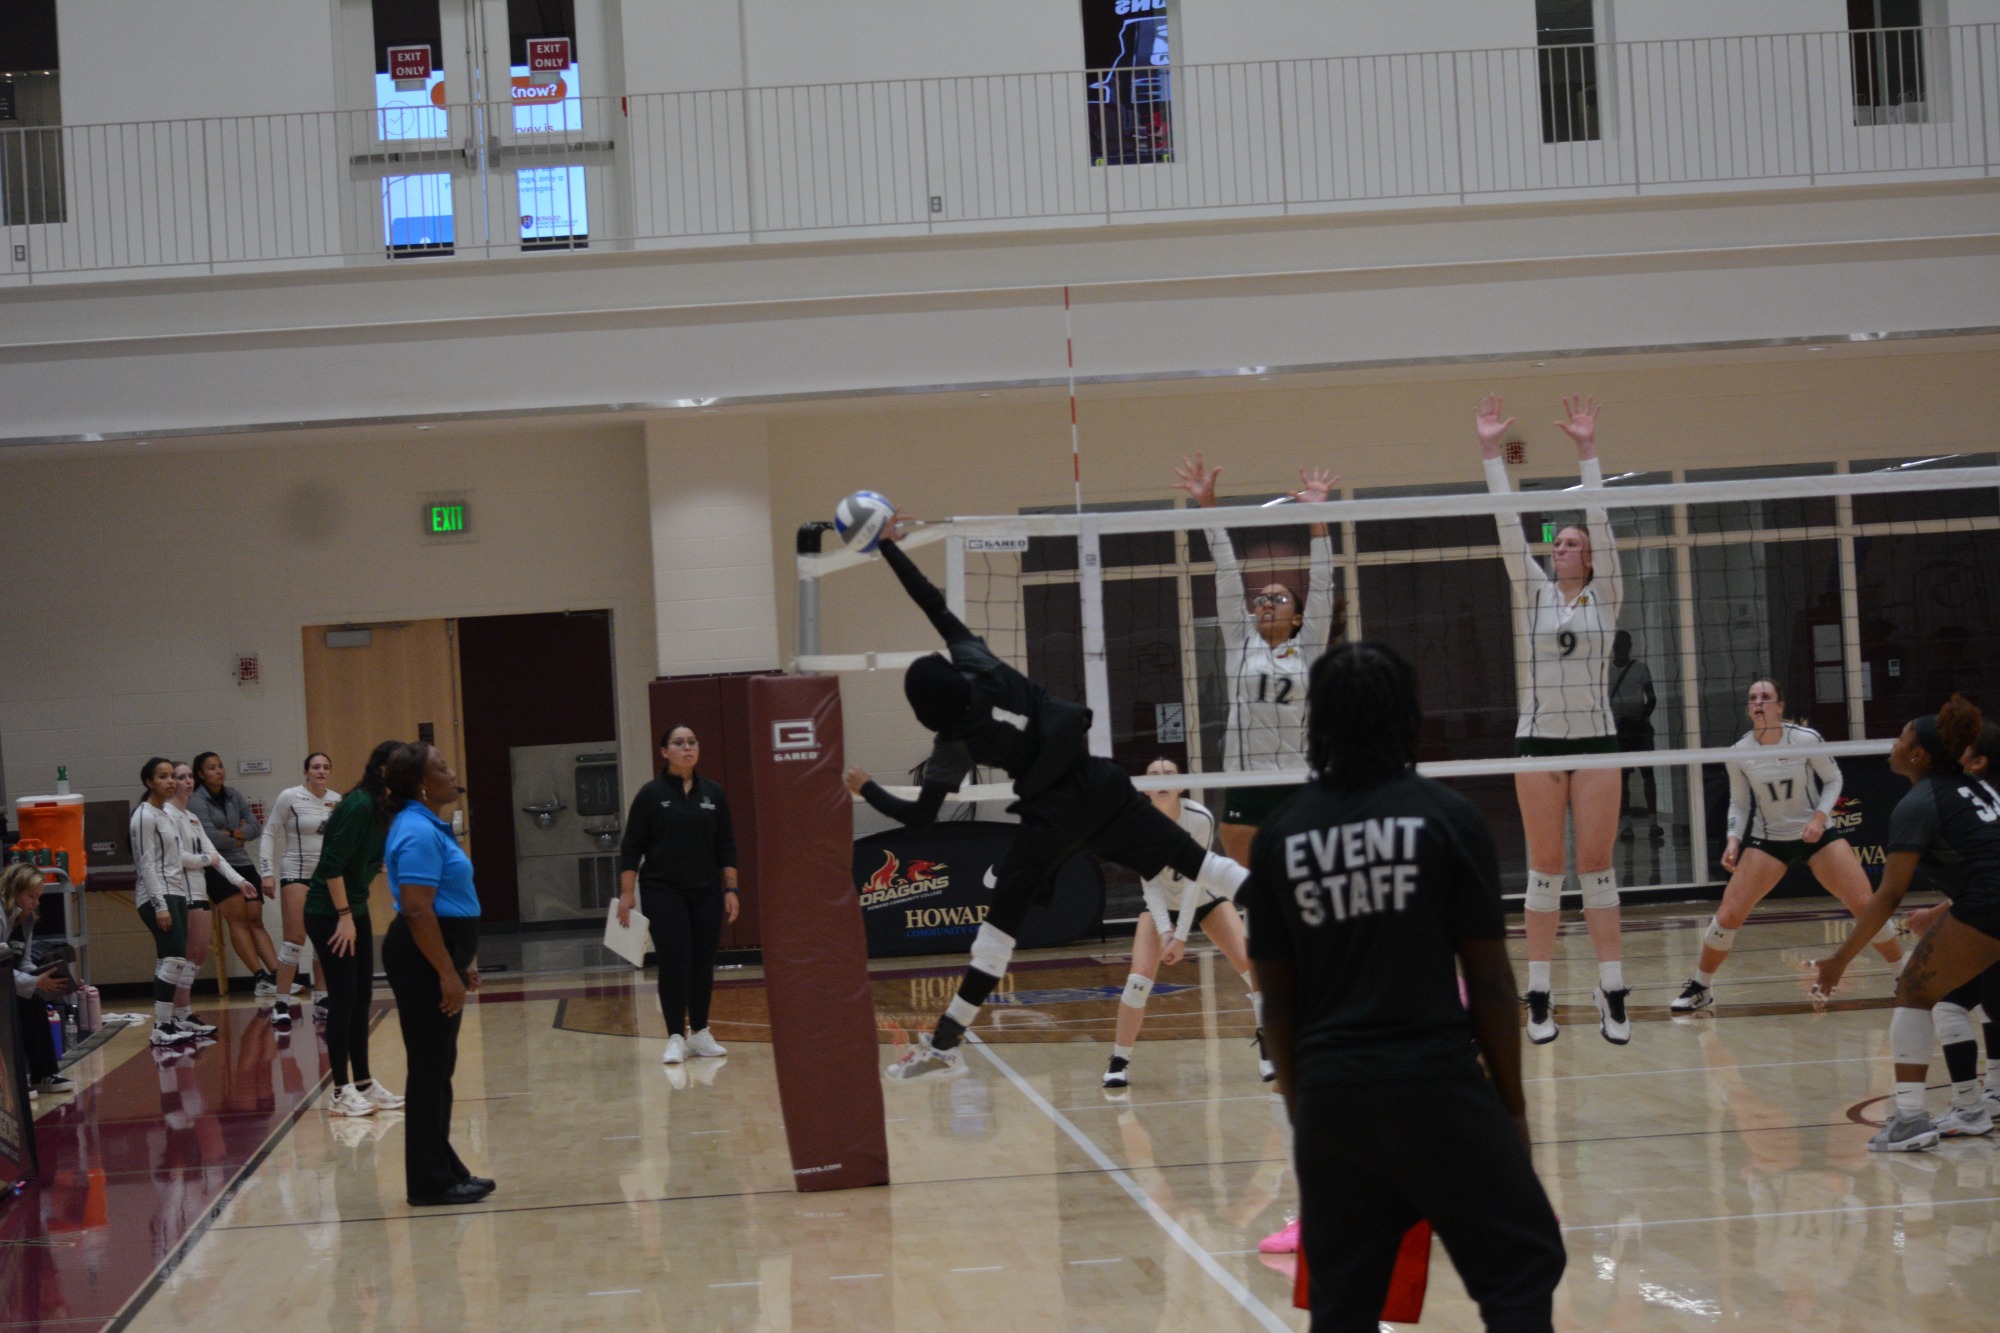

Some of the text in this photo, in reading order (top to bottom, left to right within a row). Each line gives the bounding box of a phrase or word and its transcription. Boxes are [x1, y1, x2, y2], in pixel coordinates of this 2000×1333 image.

[397, 52, 422, 62] EXIT
[537, 44, 561, 54] EXIT
[396, 66, 424, 76] ONLY
[535, 58, 563, 68] ONLY
[432, 506, 464, 532] EXIT
[1559, 631, 1576, 657] 9
[1256, 673, 1293, 705] 12
[773, 752, 820, 762] GARED
[1764, 778, 1794, 801] 17
[1284, 816, 1426, 880] EVENT
[859, 875, 950, 907] DRAGONS
[867, 889, 943, 911] HOWARD COMMUNITY COLLEGE
[1294, 864, 1420, 927] STAFF
[906, 926, 967, 938] COMMUNITY
